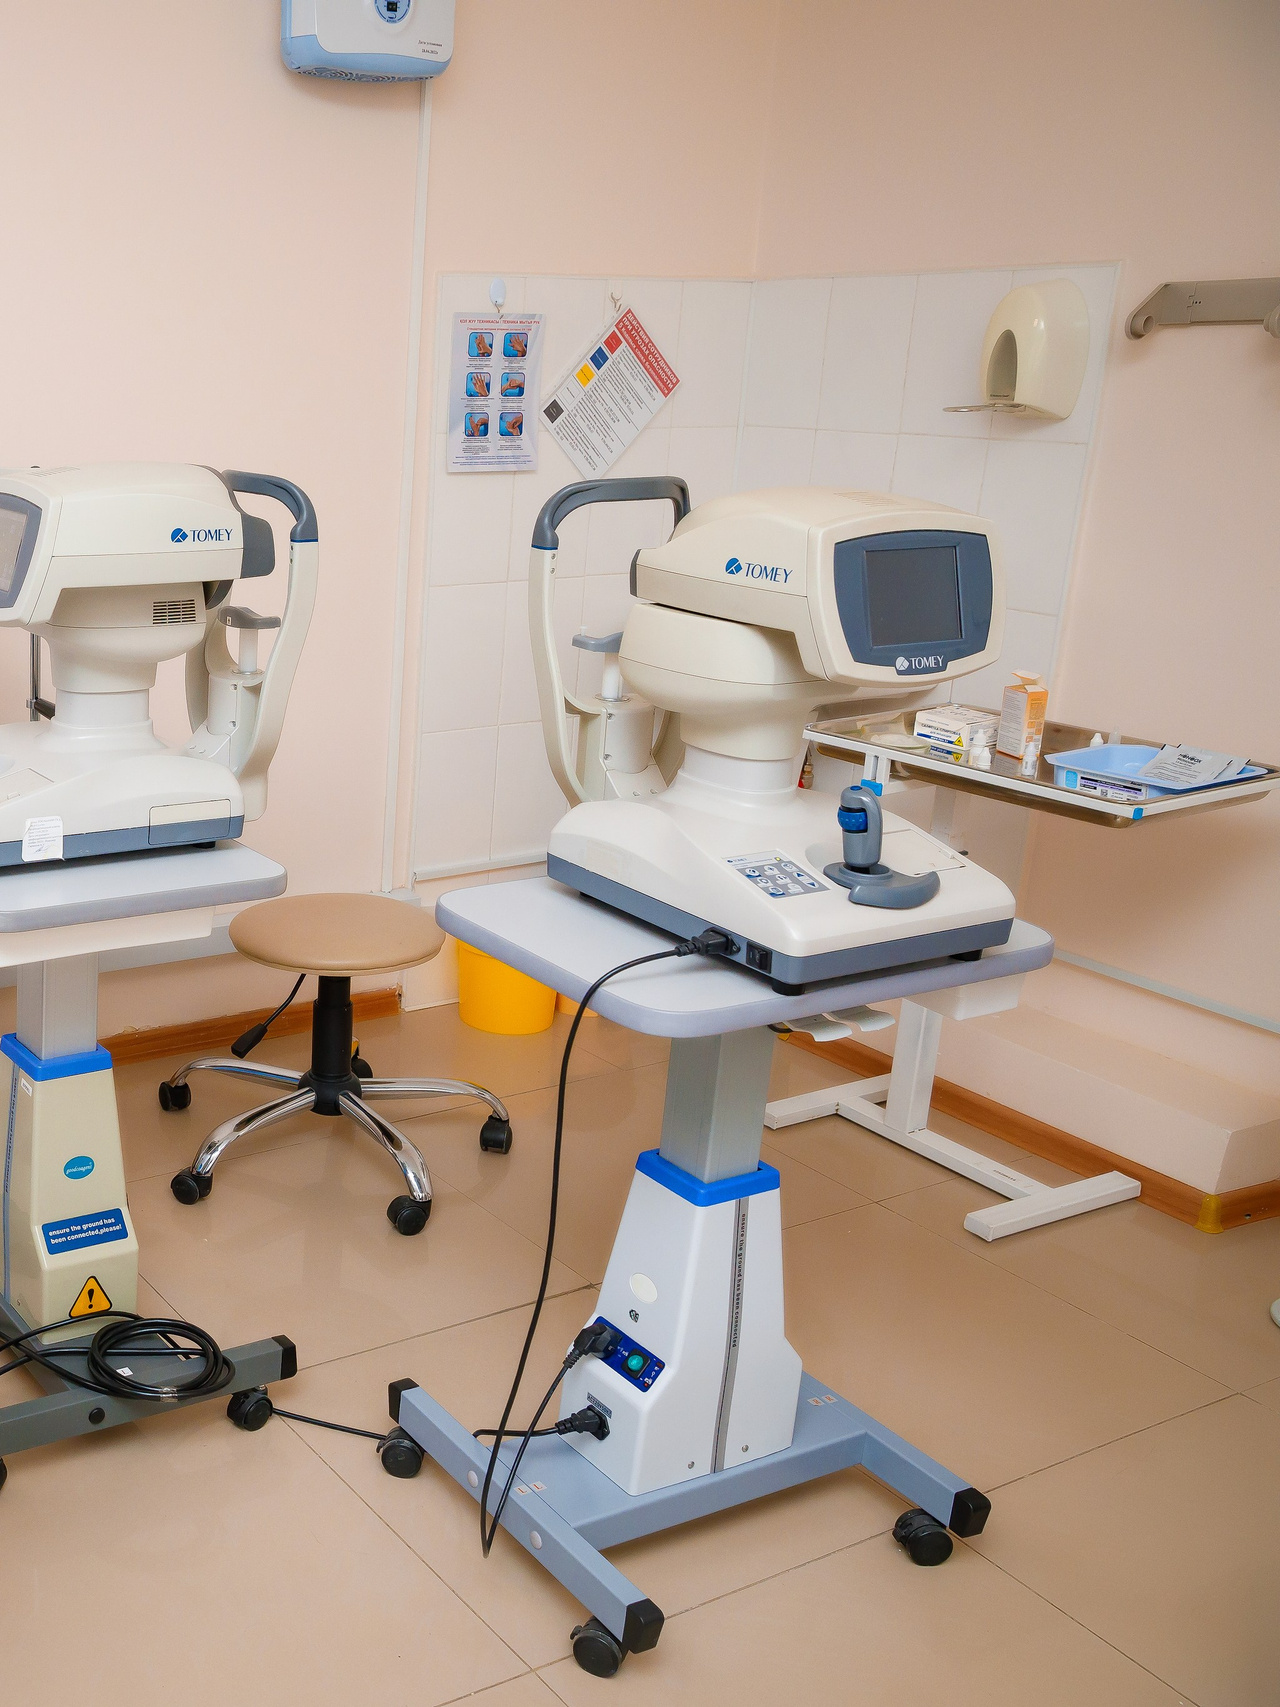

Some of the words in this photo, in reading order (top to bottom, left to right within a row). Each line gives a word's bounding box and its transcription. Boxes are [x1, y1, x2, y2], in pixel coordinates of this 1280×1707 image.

[622, 317, 632, 331] ПРИ
[631, 330, 649, 355] УГРОЗАХ
[648, 354, 673, 389] ОПАСНОСТИ
[626, 312, 648, 344] ДЕЙСТВИЯ
[648, 343, 678, 384] СОТРУДНИКОВ
[190, 528, 233, 542] TOMEY
[745, 562, 793, 583] TOMEY
[910, 655, 944, 669] TOMEY
[49, 1228, 70, 1236] ensure
[82, 1220, 103, 1230] ground
[50, 1236, 66, 1244] been
[67, 1224, 122, 1241] connected,please!
